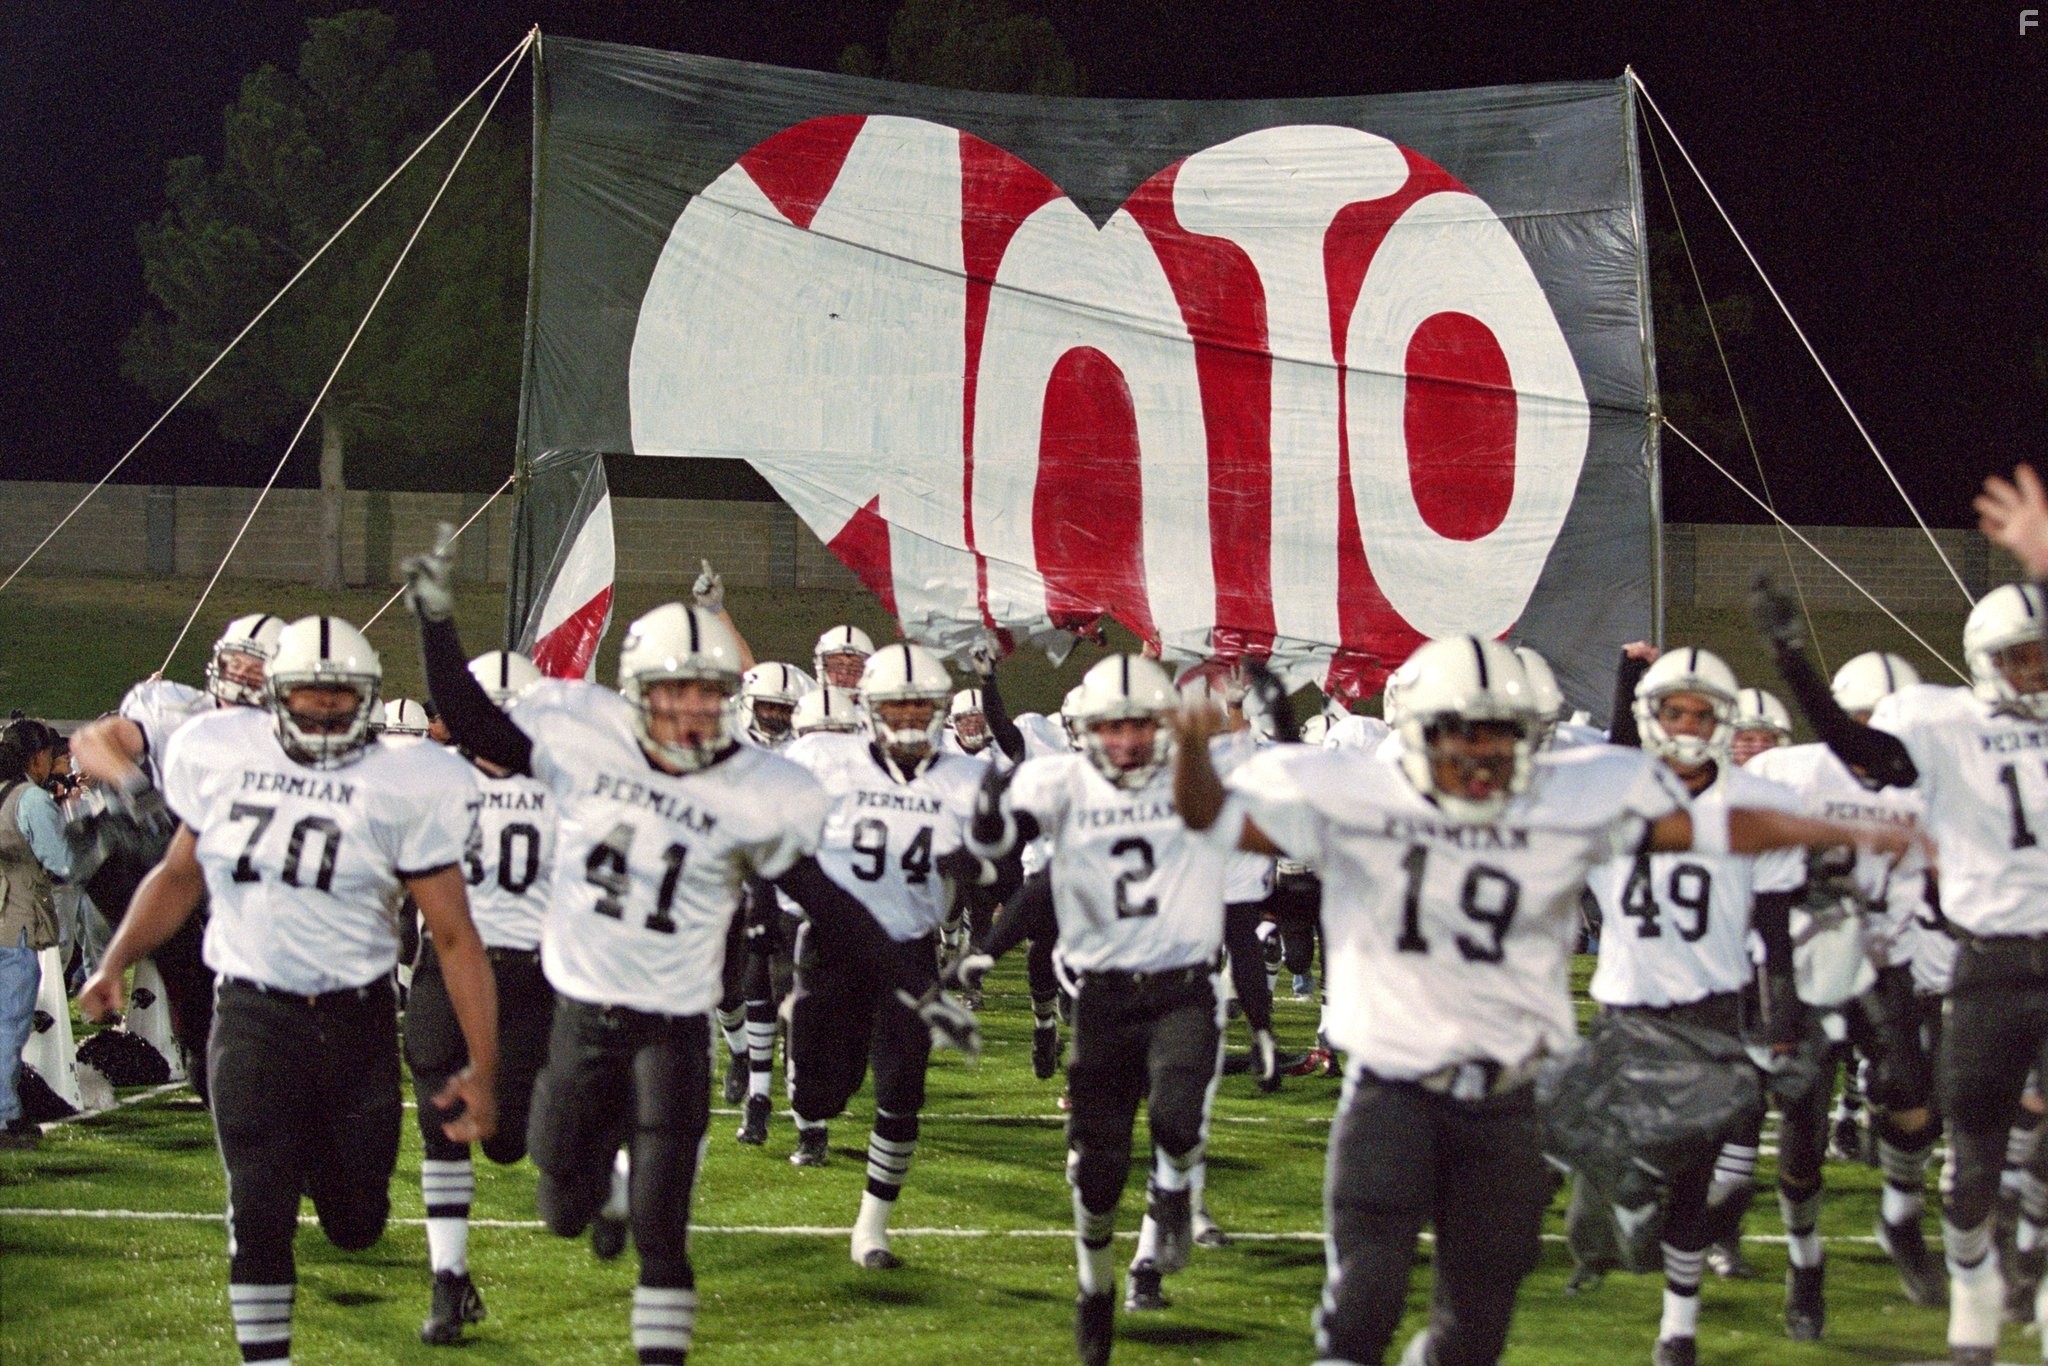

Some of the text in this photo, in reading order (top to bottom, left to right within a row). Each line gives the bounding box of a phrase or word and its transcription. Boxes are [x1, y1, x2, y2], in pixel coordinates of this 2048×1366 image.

[243, 770, 355, 803] PERMIAN
[593, 773, 717, 836] PERMIAN
[857, 790, 942, 814] PERMIAN
[1999, 764, 2048, 848] 1
[229, 801, 342, 893] 70
[585, 822, 688, 933] 41
[852, 817, 933, 883] 94
[1111, 835, 1159, 919] 2
[1396, 844, 1521, 962] 19
[1621, 850, 1711, 942] 49
